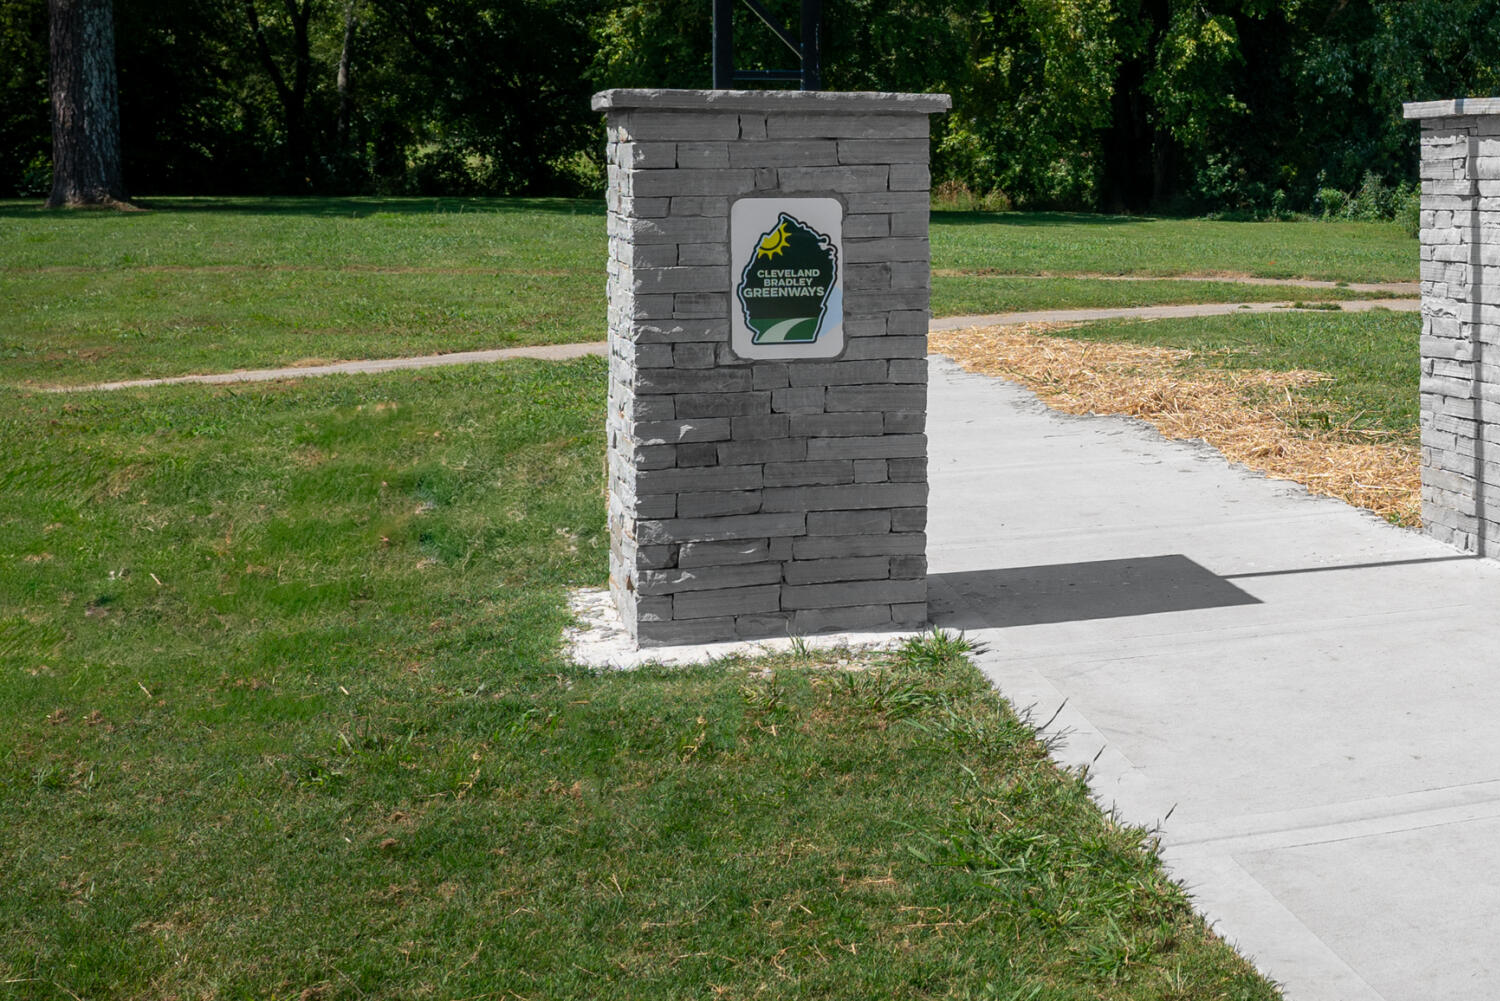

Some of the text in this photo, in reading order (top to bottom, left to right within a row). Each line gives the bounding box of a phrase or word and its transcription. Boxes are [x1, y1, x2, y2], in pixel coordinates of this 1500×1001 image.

[757, 269, 820, 278] CLEVELAND
[763, 278, 813, 287] BRADLEY
[743, 287, 825, 298] GREENWAYS
